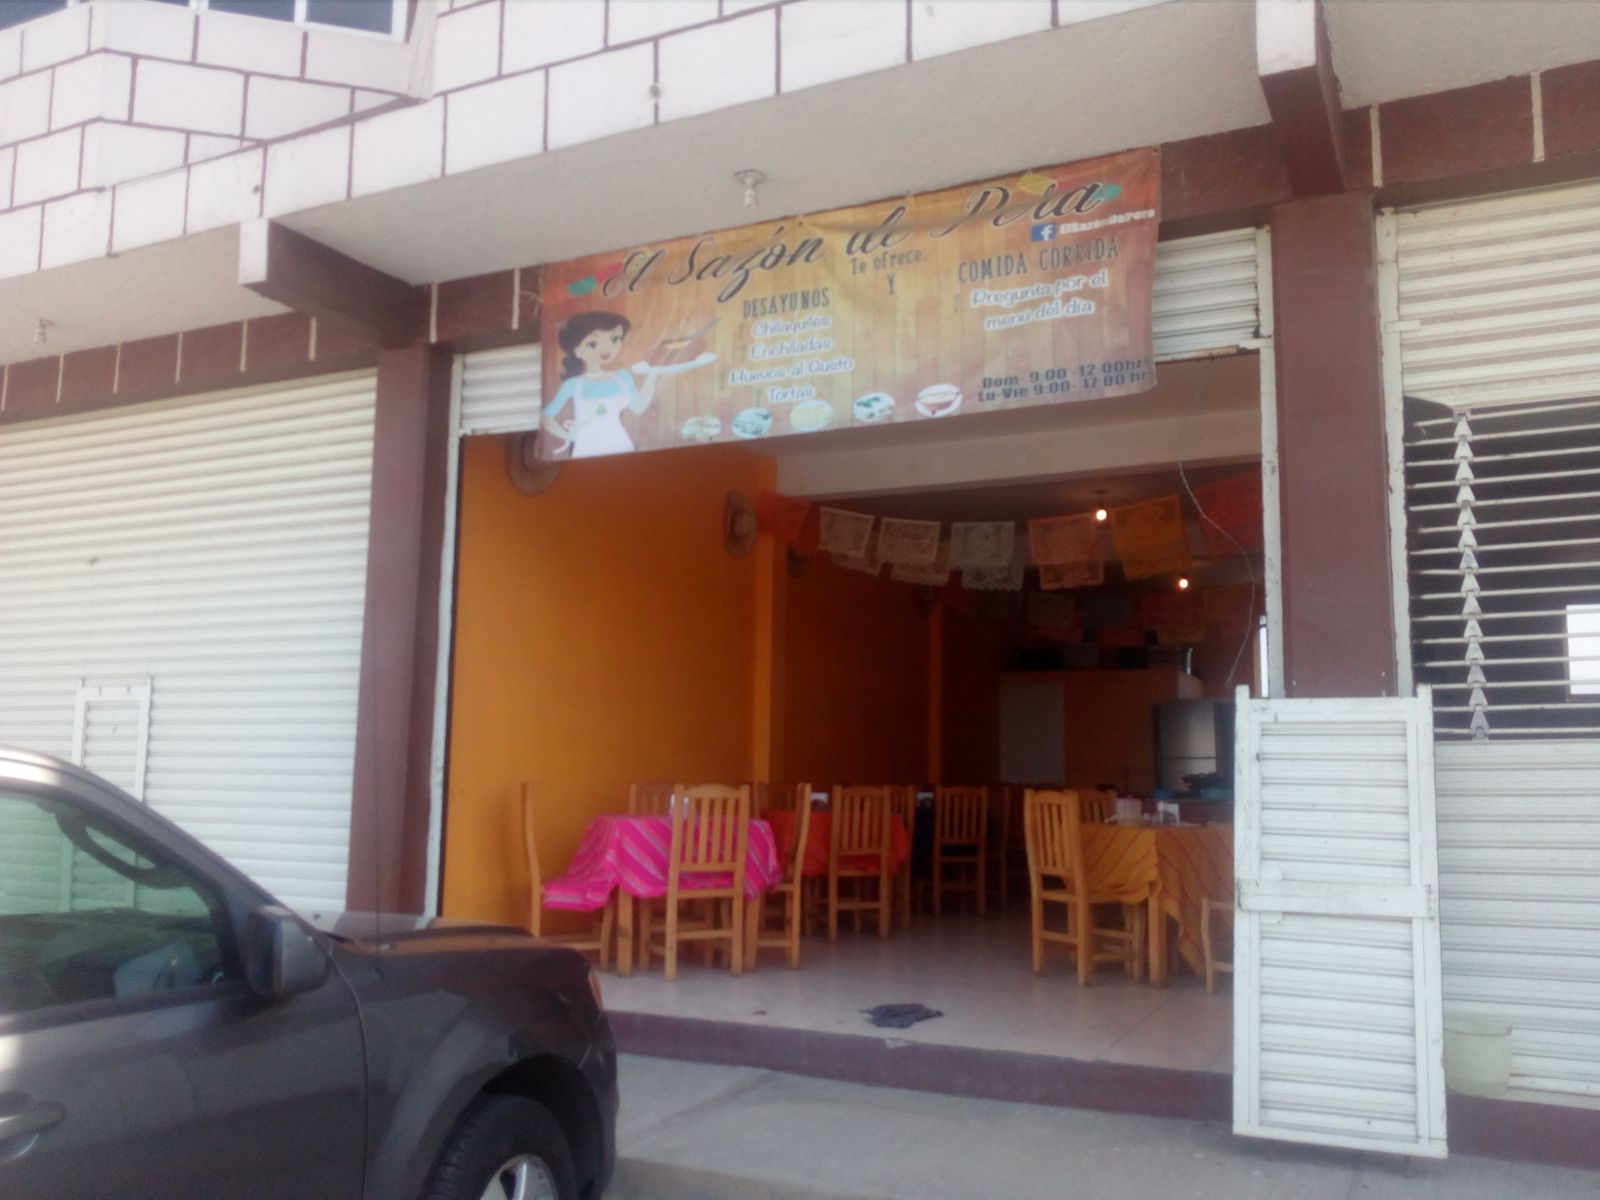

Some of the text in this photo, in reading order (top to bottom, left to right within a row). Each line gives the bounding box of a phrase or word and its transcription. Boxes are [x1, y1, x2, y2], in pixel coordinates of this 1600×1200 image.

[603, 249, 665, 297] El
[667, 226, 824, 304] Sazón
[846, 206, 911, 255] de
[851, 257, 866, 276] Te
[958, 236, 1119, 284] COMIDA CORRIDA
[971, 269, 1108, 307] Pregunta por el
[743, 287, 831, 319] DESAYUNOS
[1034, 299, 1060, 319] del
[750, 338, 833, 360] Enchiladas
[730, 356, 854, 384] Huevos al Gusto
[769, 386, 815, 402] Tortas
